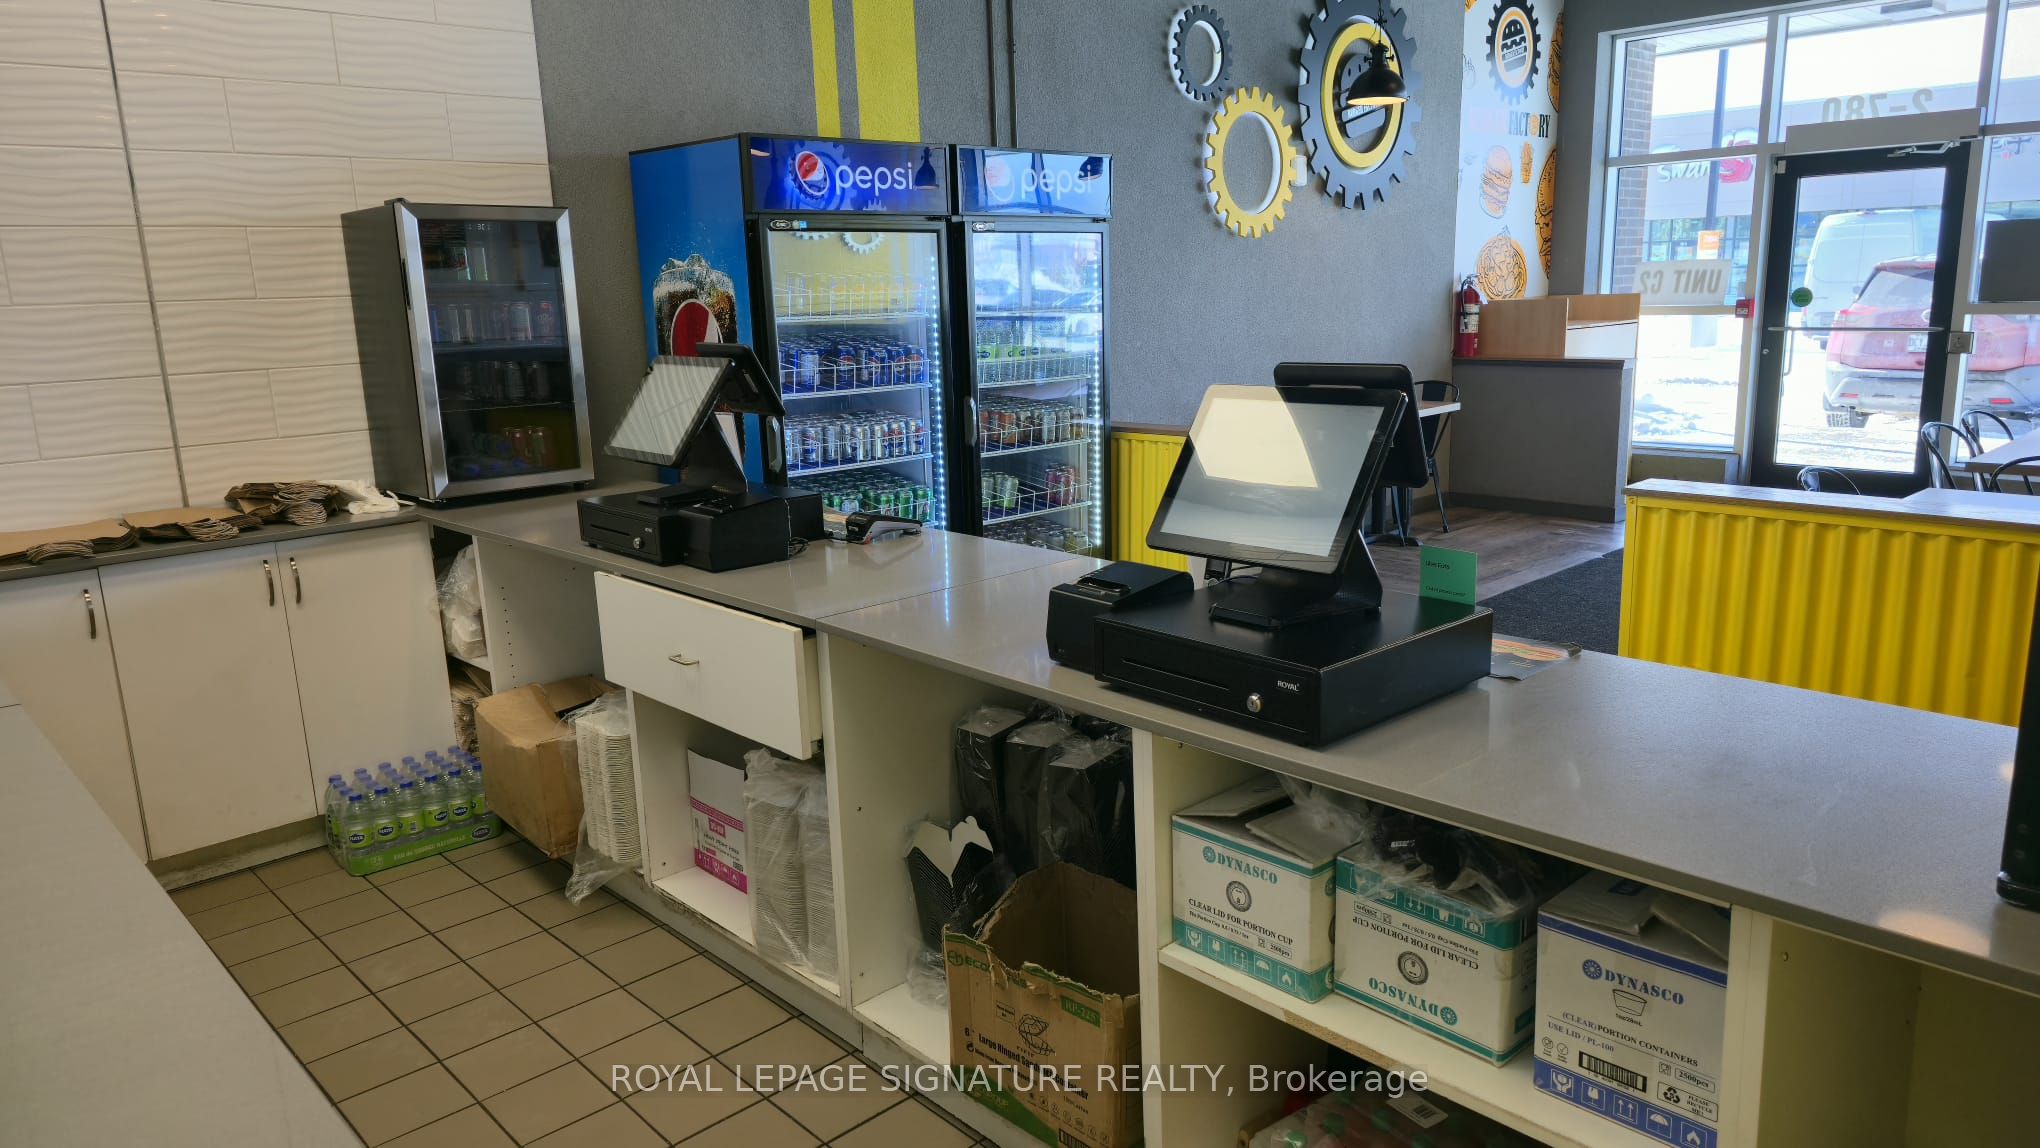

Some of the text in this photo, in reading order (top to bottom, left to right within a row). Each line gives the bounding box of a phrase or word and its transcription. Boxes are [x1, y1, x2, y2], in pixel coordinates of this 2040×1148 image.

[835, 162, 913, 198] pepsi
[1021, 164, 1092, 199] pepsi
[1217, 852, 1278, 885] DYNASCO
[1188, 898, 1293, 945] CLEAR LID FOR PORTION CUP
[1352, 916, 1479, 970] CLEAR LID FOR PORTION CUP
[1368, 977, 1439, 1013] DYNASCO
[1605, 969, 1685, 1005] DYNASCO
[978, 1033, 997, 1050] Large
[997, 1038, 1021, 1062] Hinged
[1547, 1021, 1564, 1033] USE
[1565, 1026, 1581, 1040] LID
[1597, 1024, 1637, 1044] PORTION
[1638, 1039, 1698, 1067] CONTAINERS
[1678, 1069, 1709, 1088] 2500pcs
